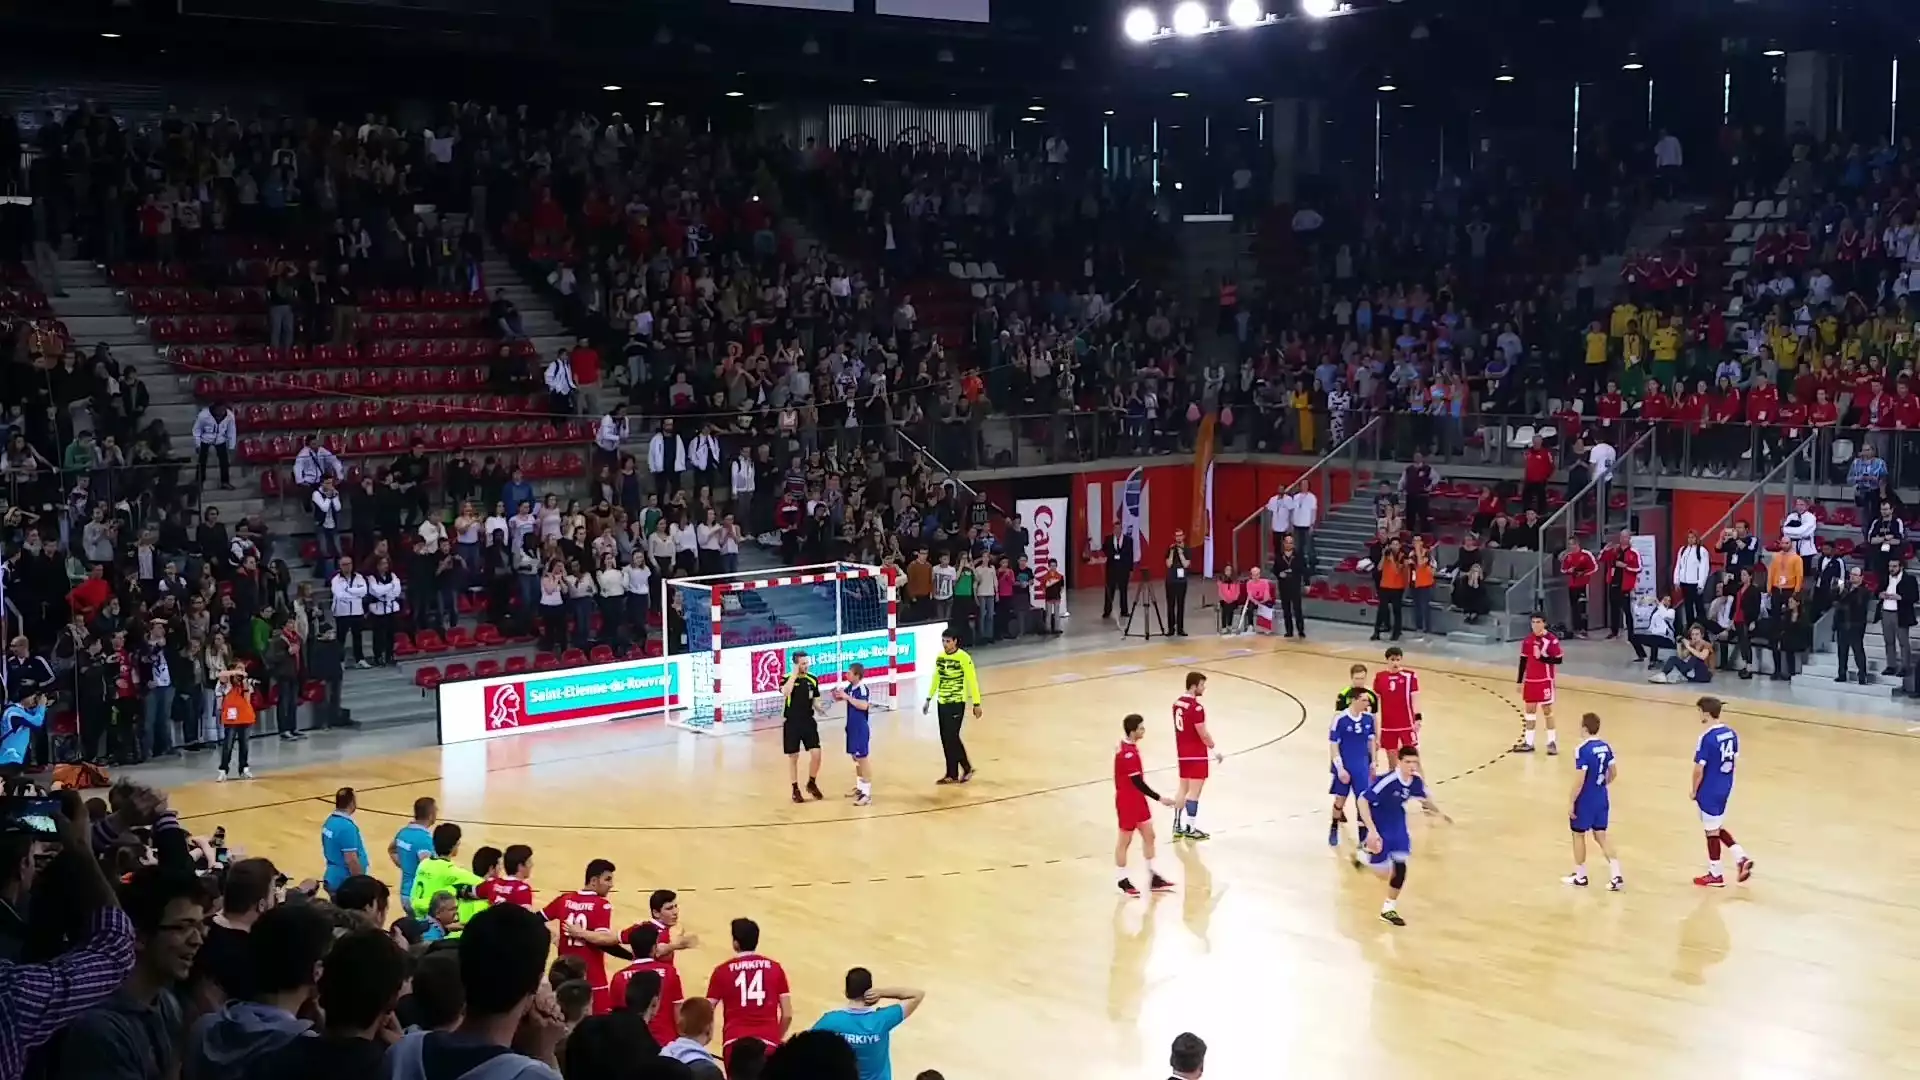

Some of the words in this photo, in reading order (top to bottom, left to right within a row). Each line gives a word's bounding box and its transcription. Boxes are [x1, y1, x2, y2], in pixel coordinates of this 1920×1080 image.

[1033, 505, 1053, 601] Canon
[529, 672, 673, 704] Saint-Etienne-du-Rouvray
[1175, 708, 1184, 731] 6
[1355, 723, 1362, 733] 5
[1719, 740, 1734, 762] 14
[1597, 753, 1606, 773] 7
[734, 969, 767, 1008] 14
